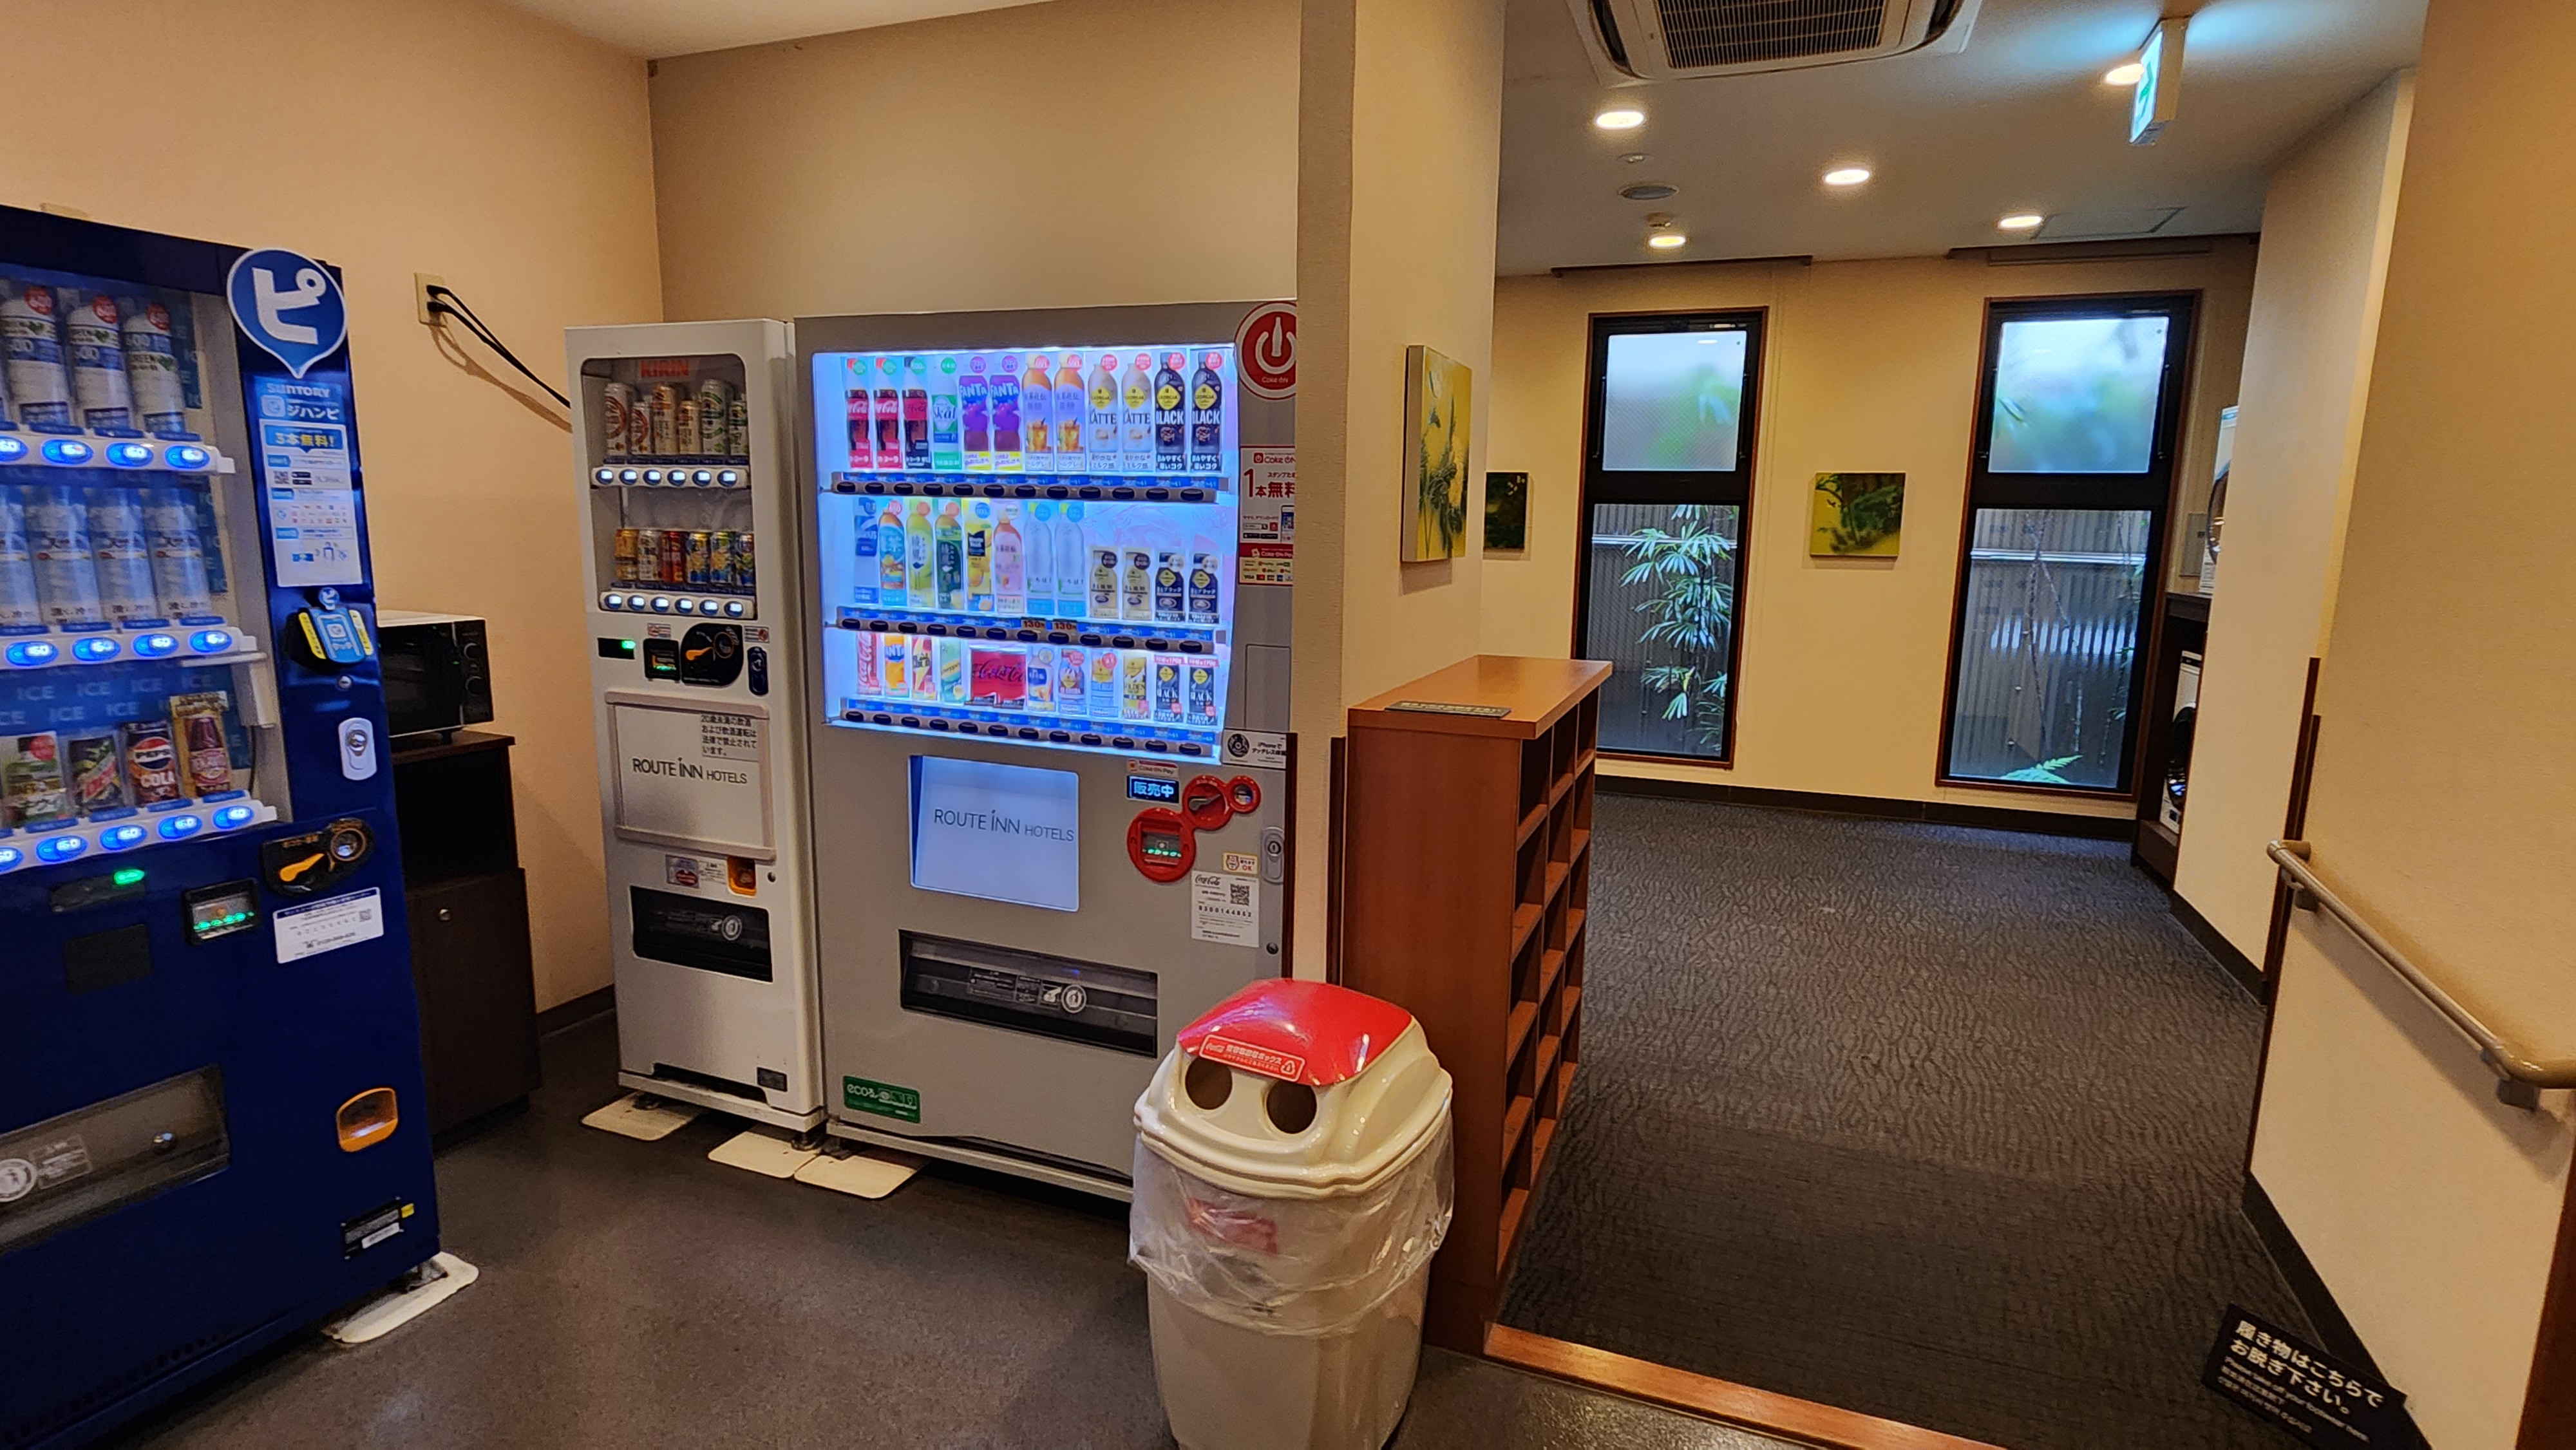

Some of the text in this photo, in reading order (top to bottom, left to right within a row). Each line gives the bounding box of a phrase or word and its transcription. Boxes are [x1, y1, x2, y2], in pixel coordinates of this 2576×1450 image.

[252, 268, 327, 345] ピ
[959, 382, 987, 398] FANTA
[990, 382, 1019, 397] FANTA
[632, 758, 677, 777] ROUTE
[706, 769, 748, 784] HOTELS
[1133, 781, 1174, 798] 販売中
[934, 809, 987, 831] ROUTE
[1024, 824, 1075, 842] HOTELS
[2235, 1320, 2384, 1408] 履き物はこちらで
